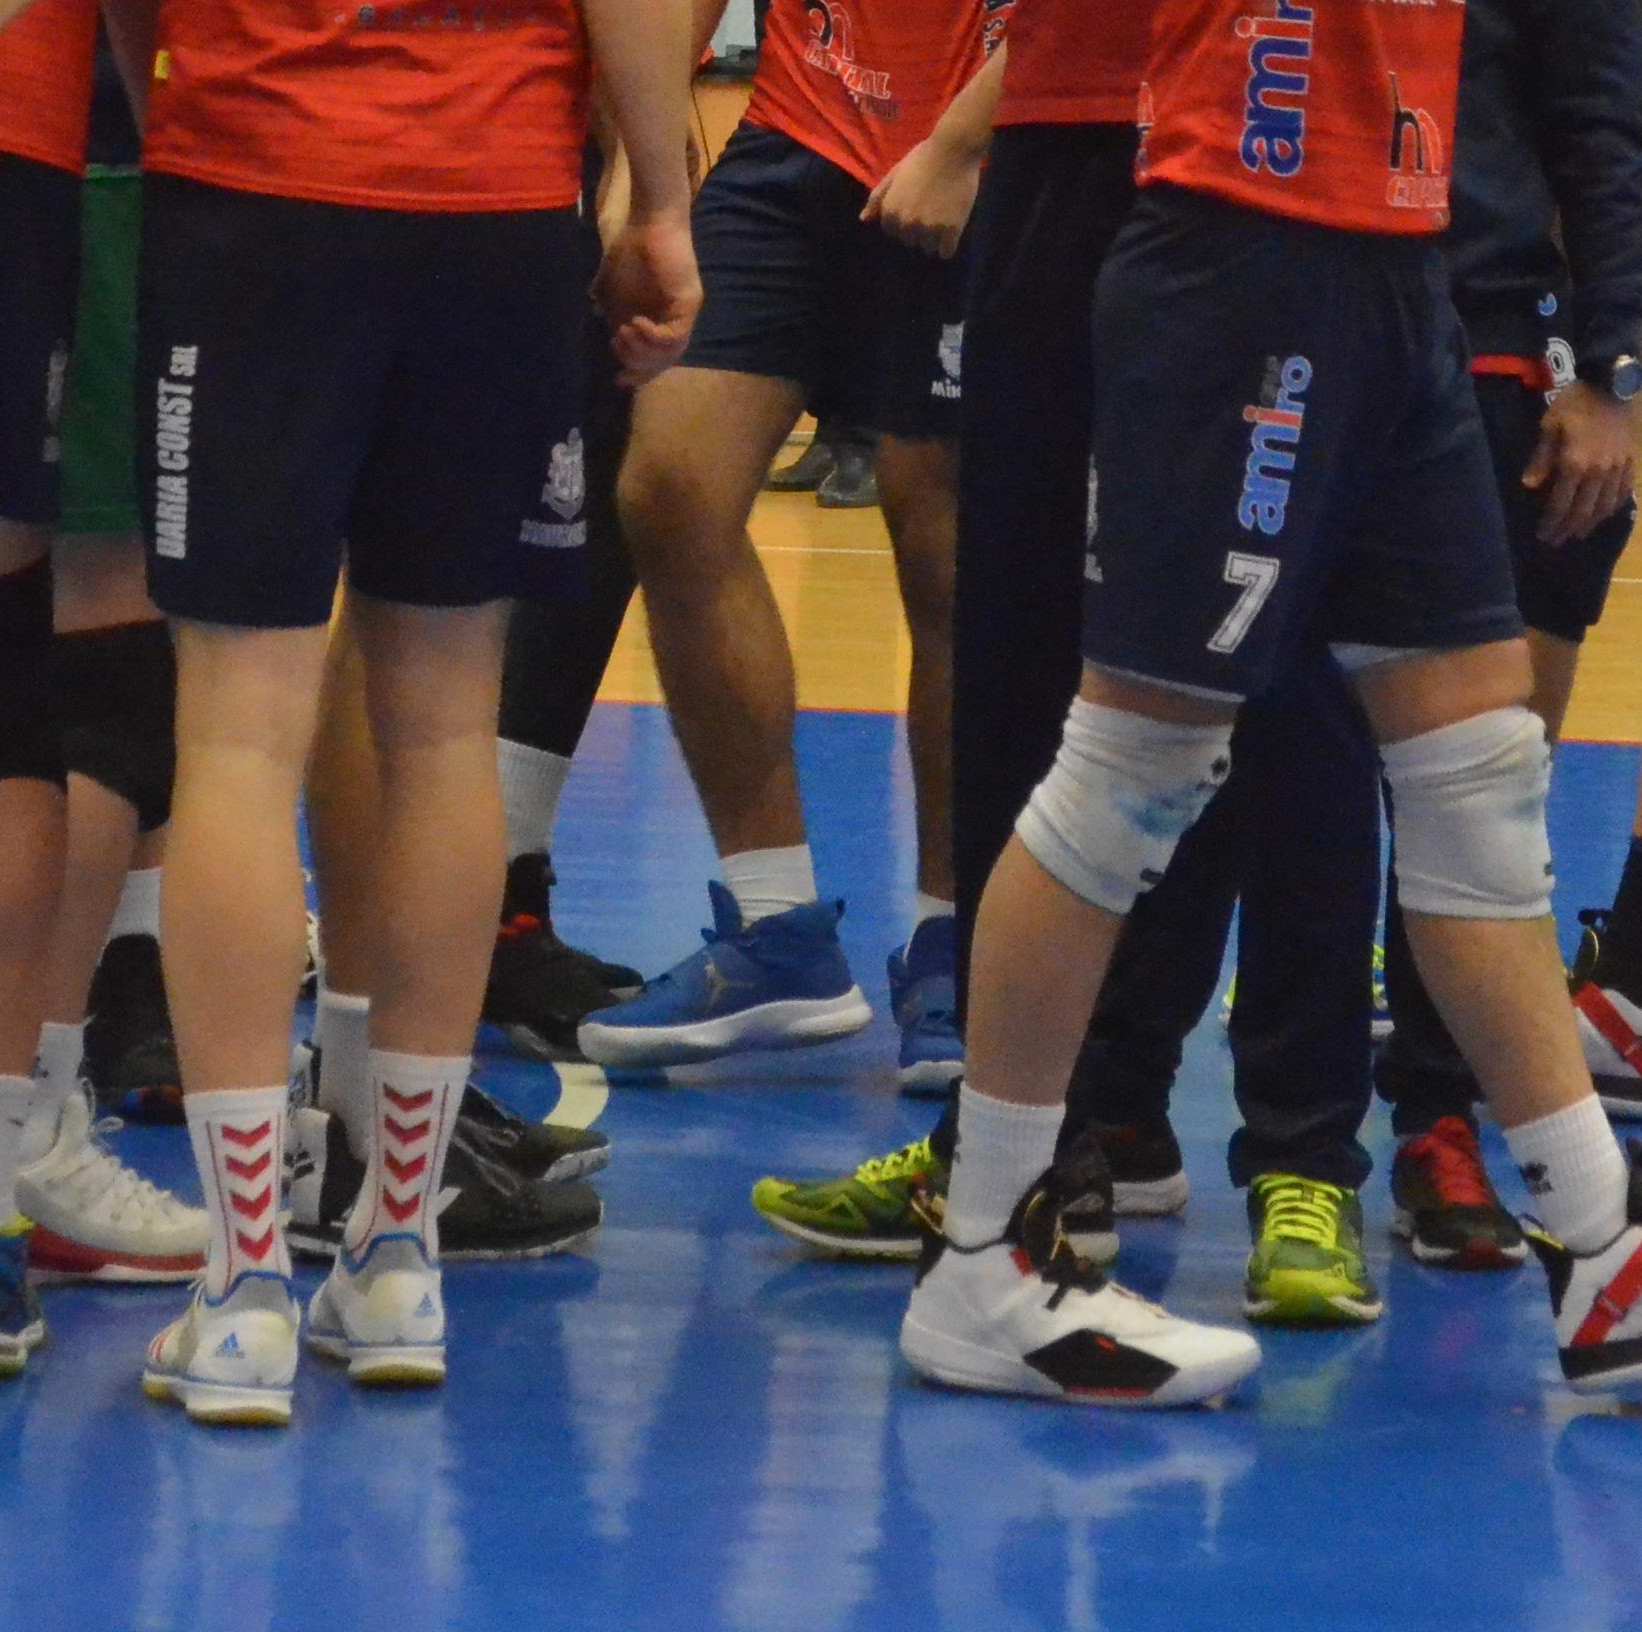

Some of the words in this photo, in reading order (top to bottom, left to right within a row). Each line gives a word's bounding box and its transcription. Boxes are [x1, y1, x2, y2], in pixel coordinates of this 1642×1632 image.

[156, 376, 194, 473] CONST
[1237, 355, 1314, 536] amiro
[154, 474, 189, 560] DARIA
[1206, 550, 1281, 655] 7
